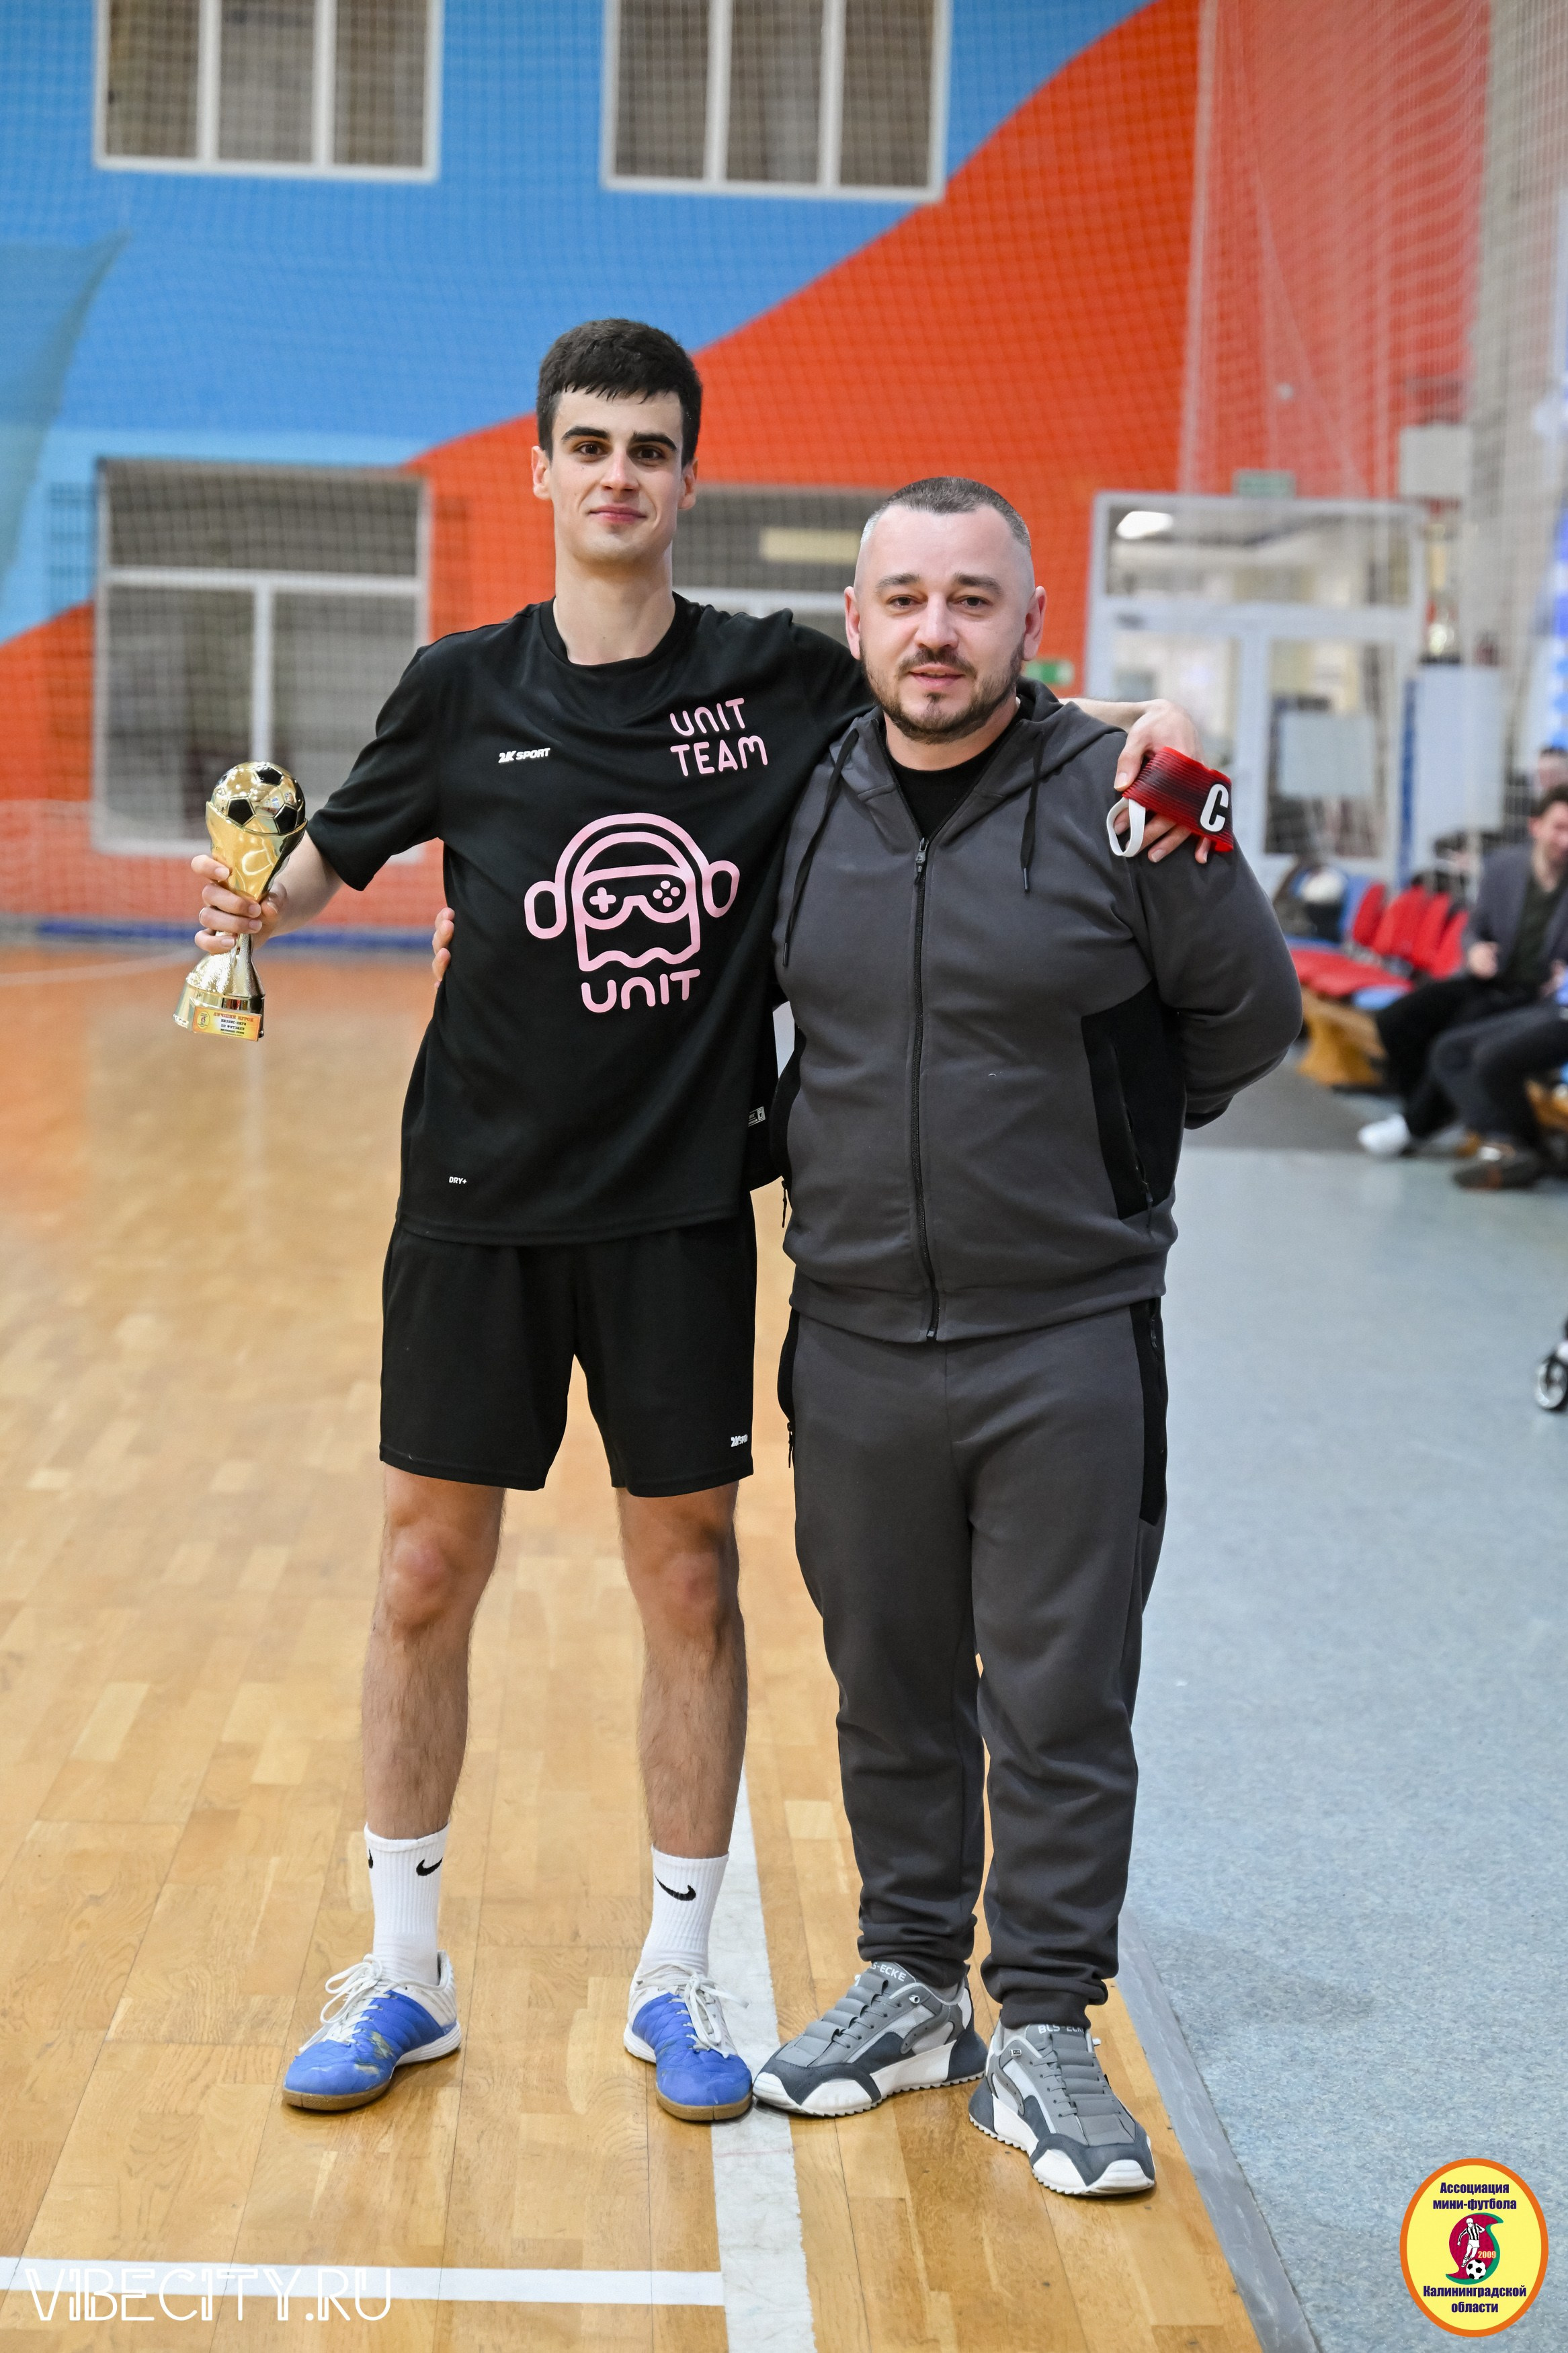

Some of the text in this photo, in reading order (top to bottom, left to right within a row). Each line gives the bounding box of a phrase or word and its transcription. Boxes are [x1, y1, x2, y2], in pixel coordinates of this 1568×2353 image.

[669, 697, 746, 736] UNIT
[498, 747, 550, 763] 2K SPORT
[670, 735, 768, 776] TEAM
[1200, 783, 1229, 832] C
[581, 968, 700, 1013] UNIT
[448, 1176, 467, 1185] DRY+
[870, 1962, 907, 1982] S-ECKE
